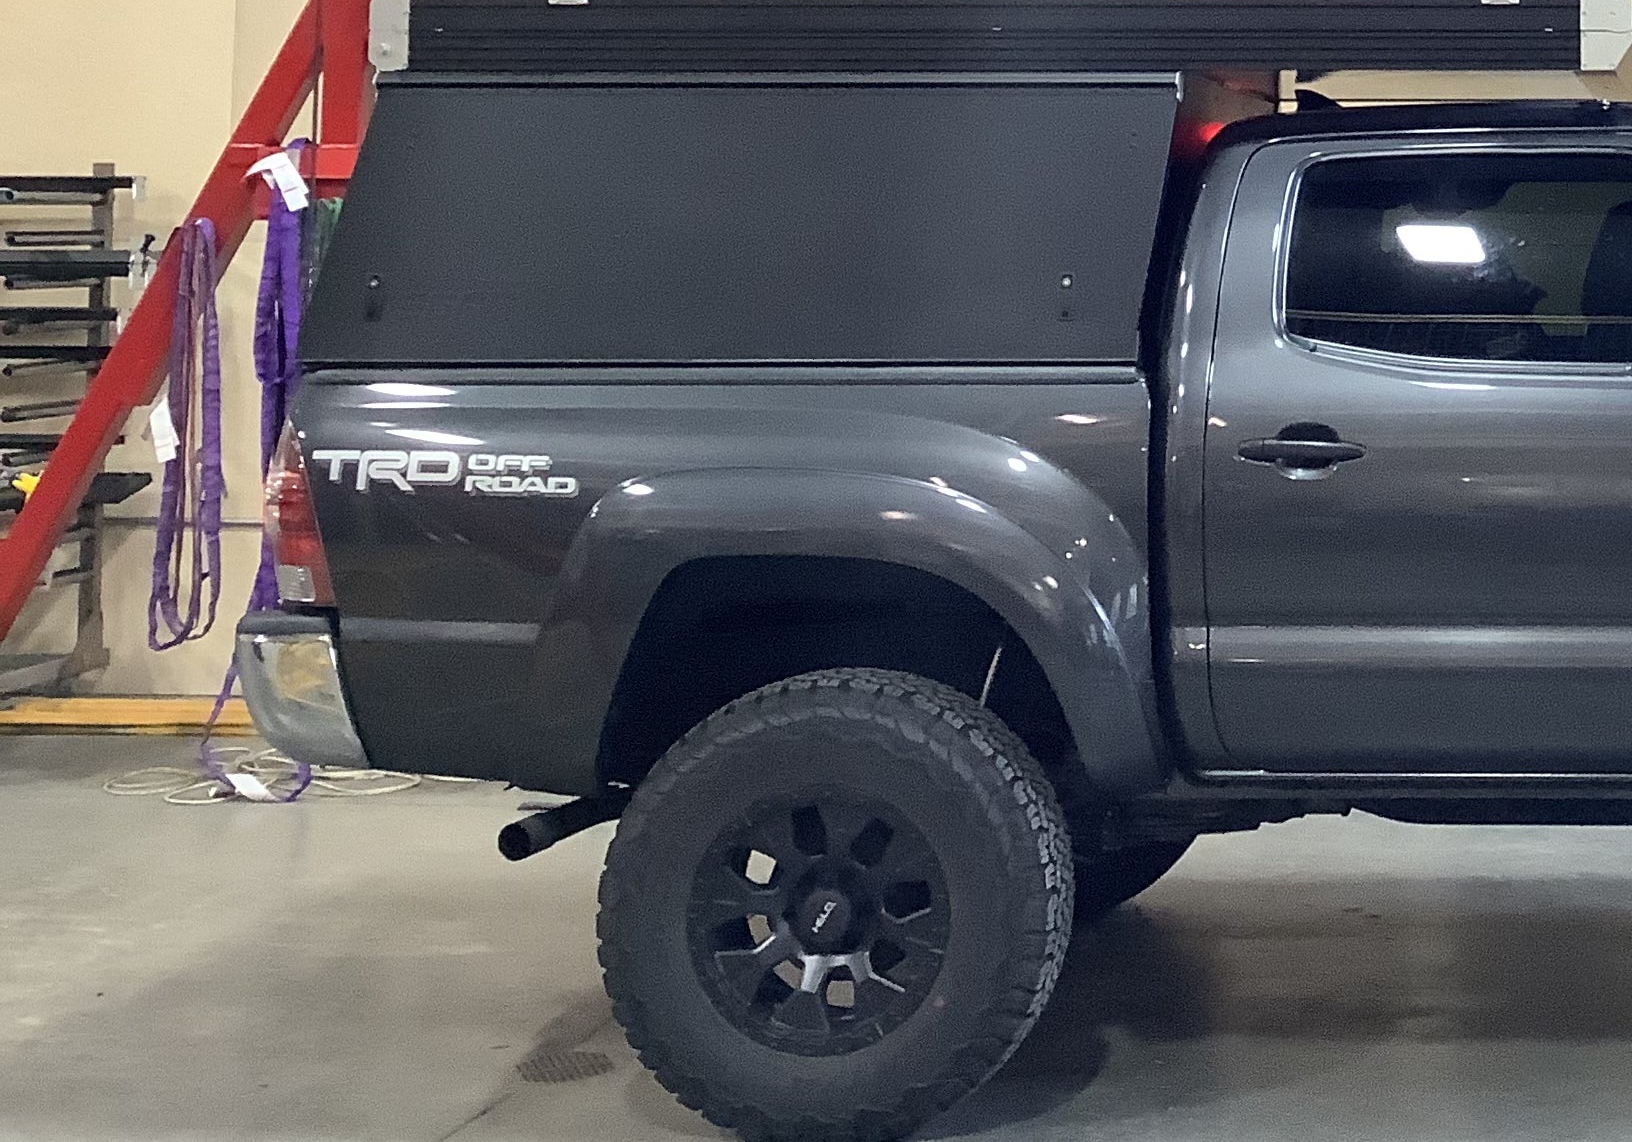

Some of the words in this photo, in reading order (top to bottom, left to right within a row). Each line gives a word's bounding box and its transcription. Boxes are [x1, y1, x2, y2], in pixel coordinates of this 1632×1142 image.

[312, 449, 463, 494] TRD
[467, 454, 553, 474] OFF
[464, 475, 580, 497] ROAD
